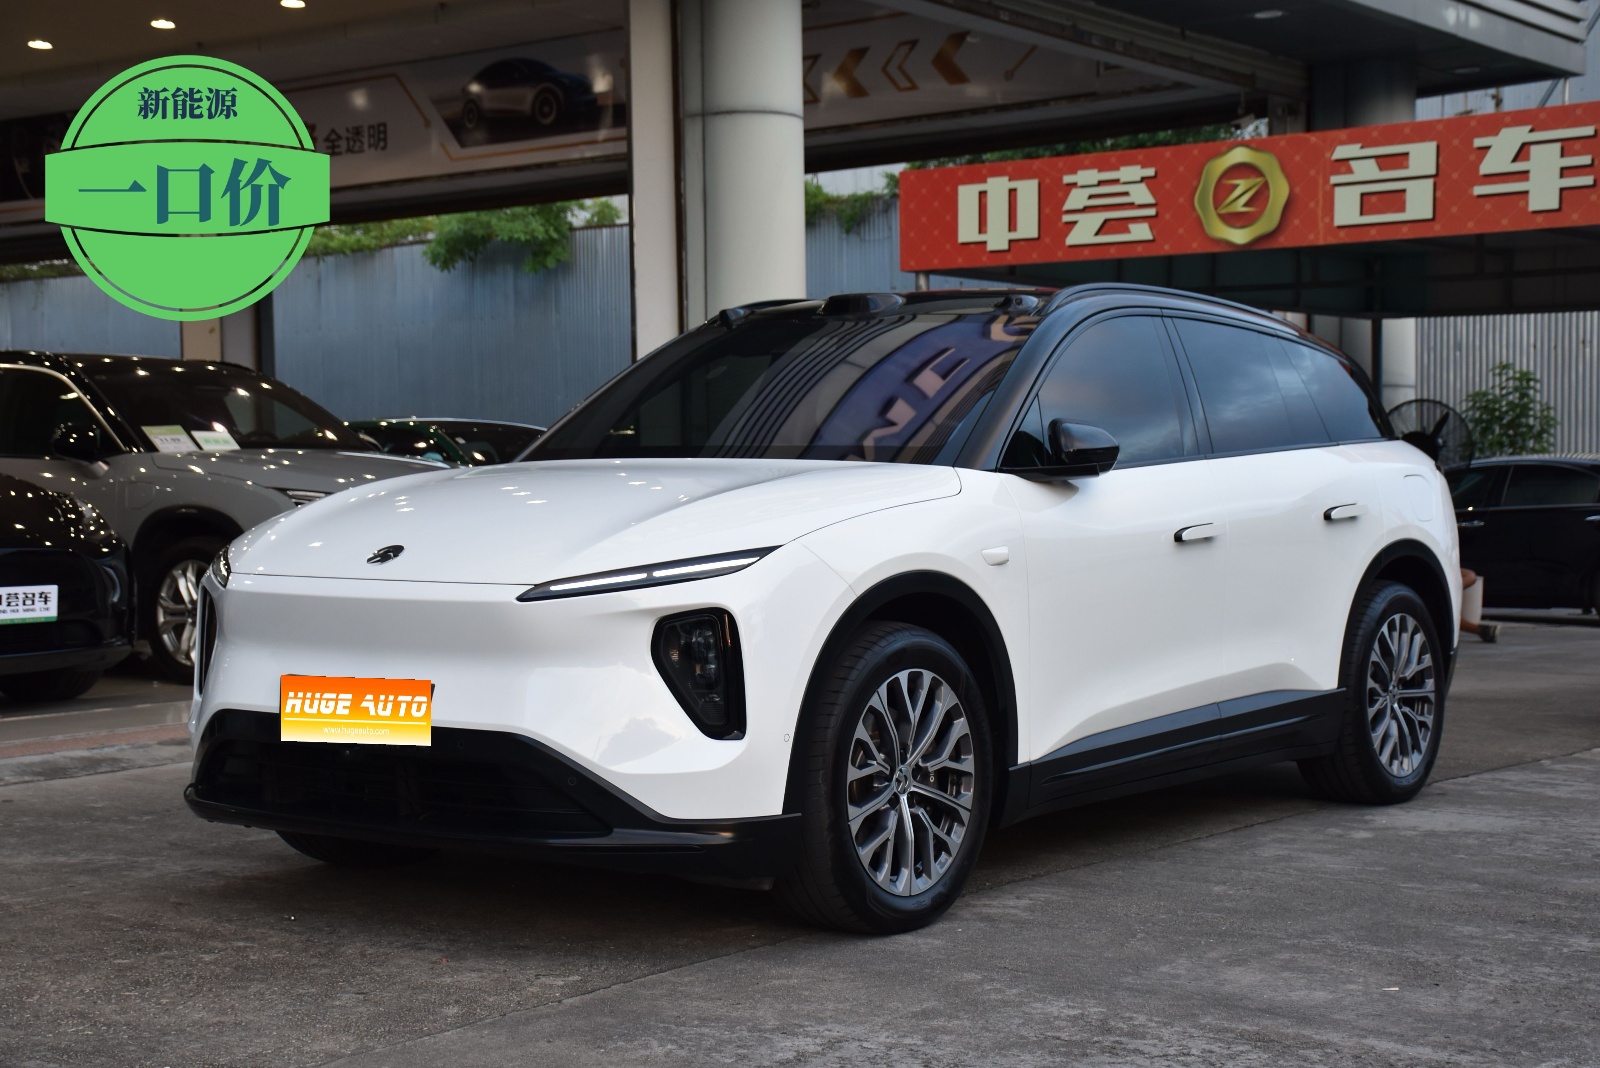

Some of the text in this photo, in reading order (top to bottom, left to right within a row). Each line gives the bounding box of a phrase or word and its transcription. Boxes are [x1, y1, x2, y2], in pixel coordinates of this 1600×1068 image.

[323, 122, 387, 155] 全透明
[957, 164, 1158, 252] 中荟
[1330, 124, 1596, 228] 名车
[0, 591, 52, 607] 荟名车
